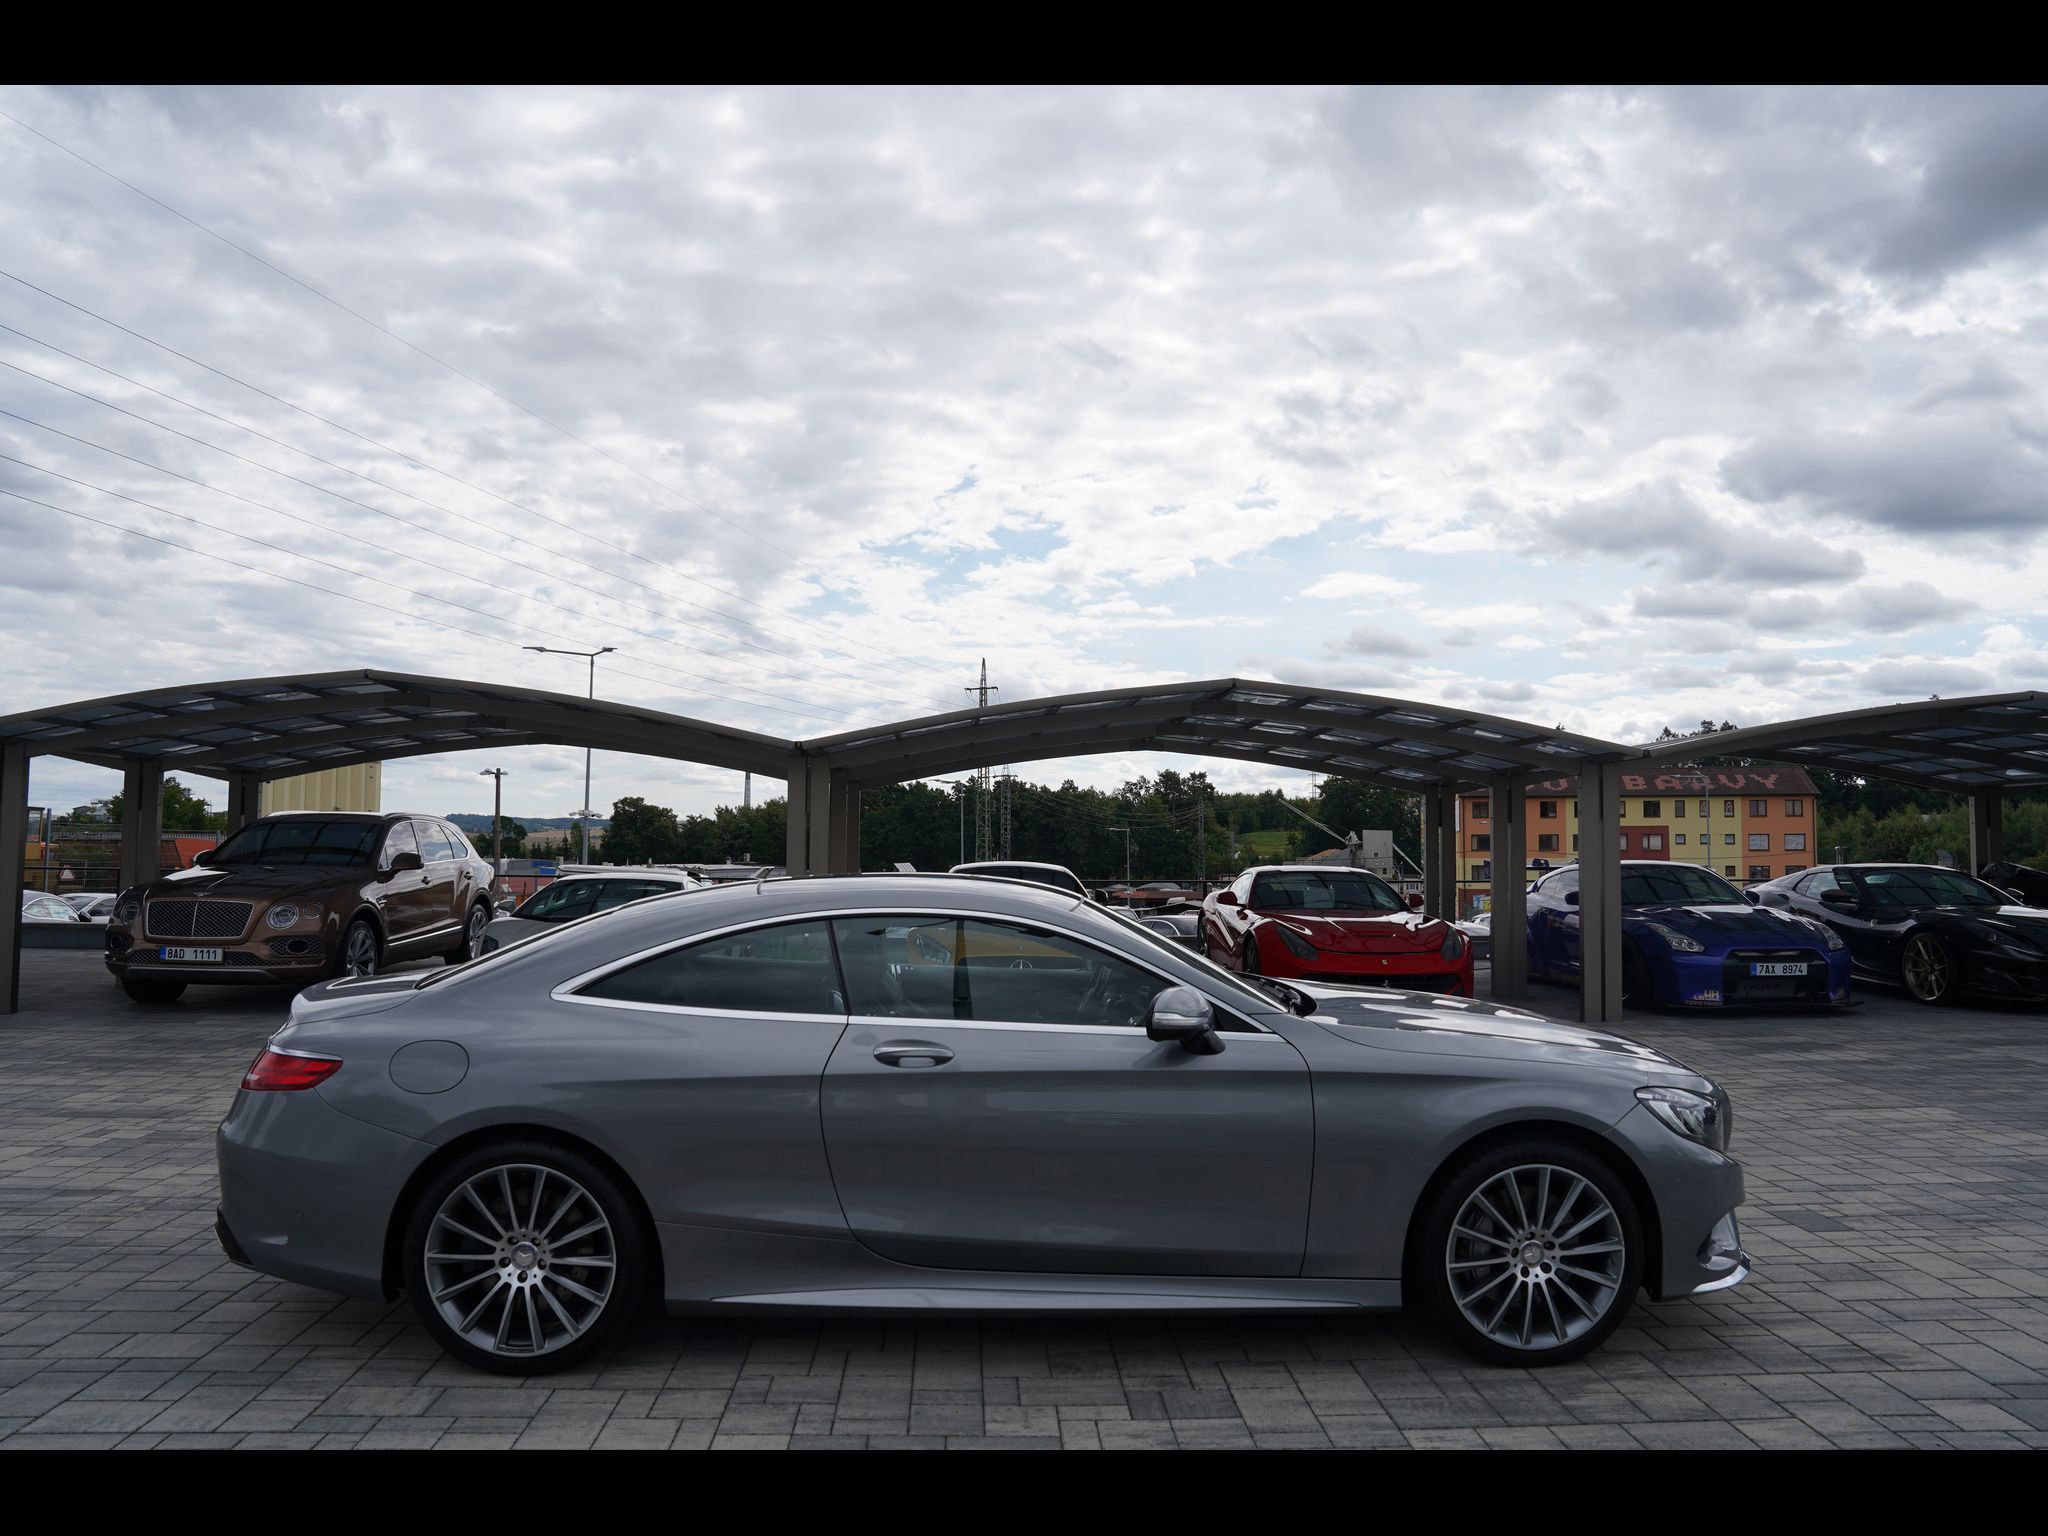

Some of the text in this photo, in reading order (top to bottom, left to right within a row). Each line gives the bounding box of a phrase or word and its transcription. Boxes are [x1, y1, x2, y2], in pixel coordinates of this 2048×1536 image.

[167, 948, 217, 960] 8AD 1111
[1758, 964, 1803, 975] 7AX 8974
